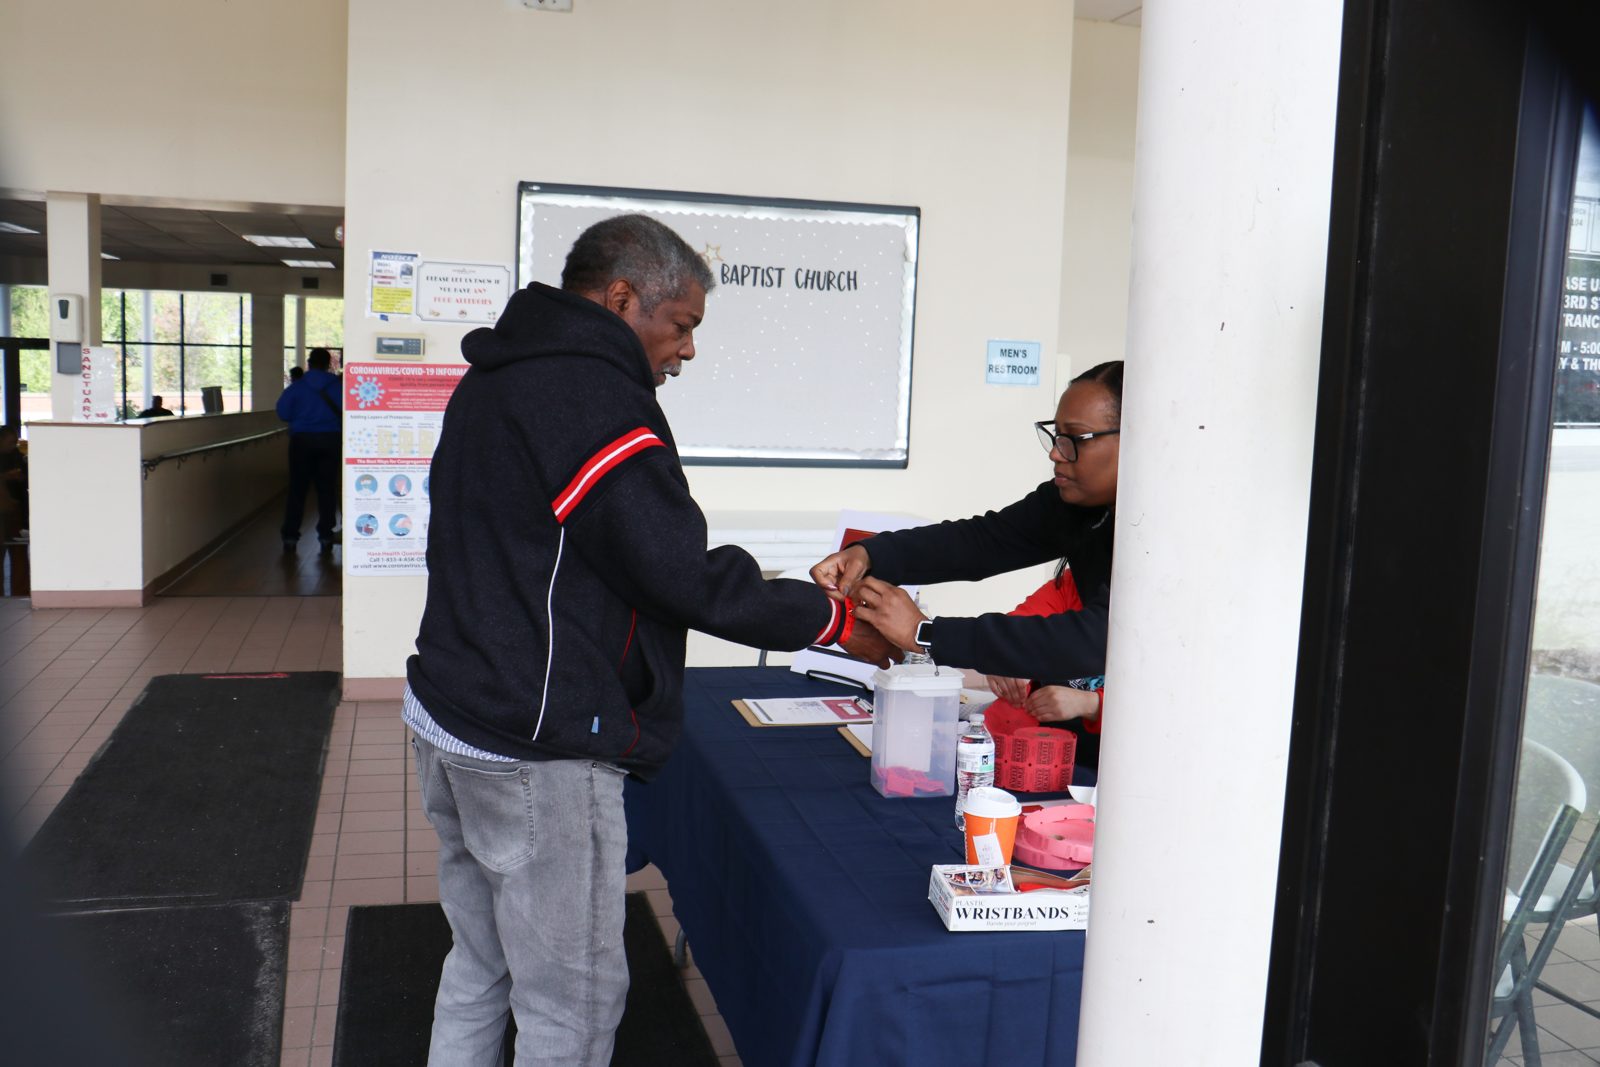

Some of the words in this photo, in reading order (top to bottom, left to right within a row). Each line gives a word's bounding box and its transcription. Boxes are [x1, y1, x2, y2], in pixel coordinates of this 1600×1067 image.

[721, 263, 785, 289] BAPTIST
[795, 267, 858, 292] CHURCH
[1591, 278, 1600, 292] U
[456, 297, 492, 305] ALLERGIES
[1564, 294, 1587, 309] 3RD
[1591, 297, 1600, 310] S
[1563, 313, 1600, 329] RANC
[1000, 348, 1027, 359] MEN'S
[988, 364, 1038, 375] RESTROOM
[1558, 357, 1568, 370] Y
[1571, 357, 1579, 370] &
[350, 366, 435, 376] CORONAVIRUS/COVID-19
[82, 348, 92, 420] SANCTUARY
[955, 907, 1069, 920] WRISTBANDS
